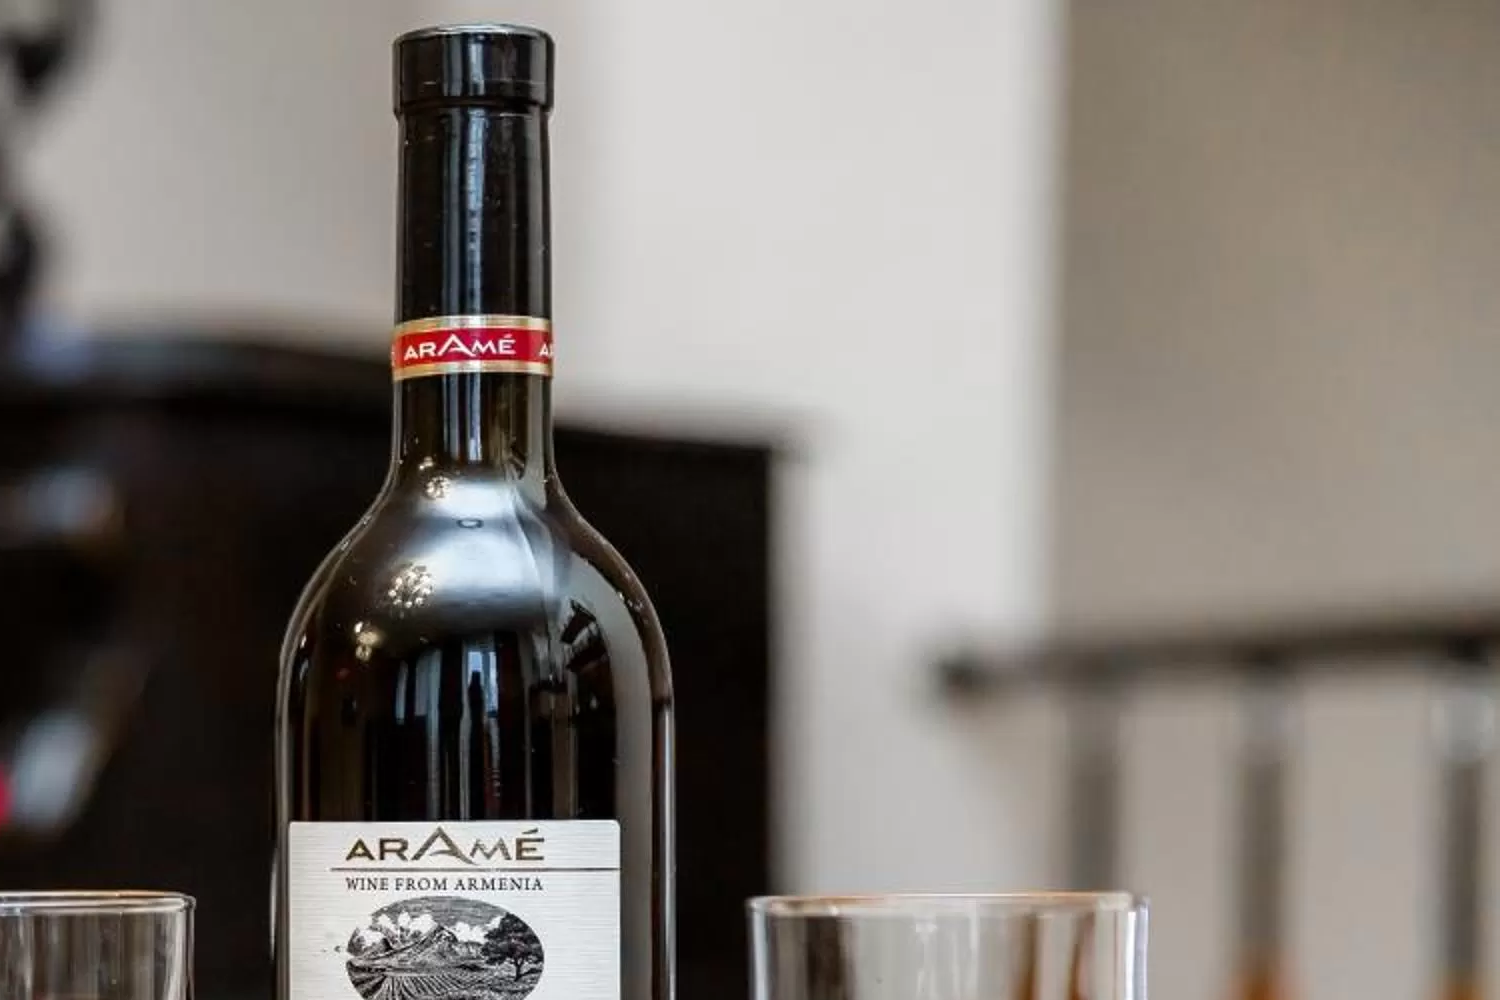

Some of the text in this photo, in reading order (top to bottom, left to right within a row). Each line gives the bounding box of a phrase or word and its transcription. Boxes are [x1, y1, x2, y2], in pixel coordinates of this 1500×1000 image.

[404, 333, 517, 361] ARAMÉ
[345, 826, 545, 866] ARAMÉ
[345, 877, 544, 891] WINE FROM ARMENIA
